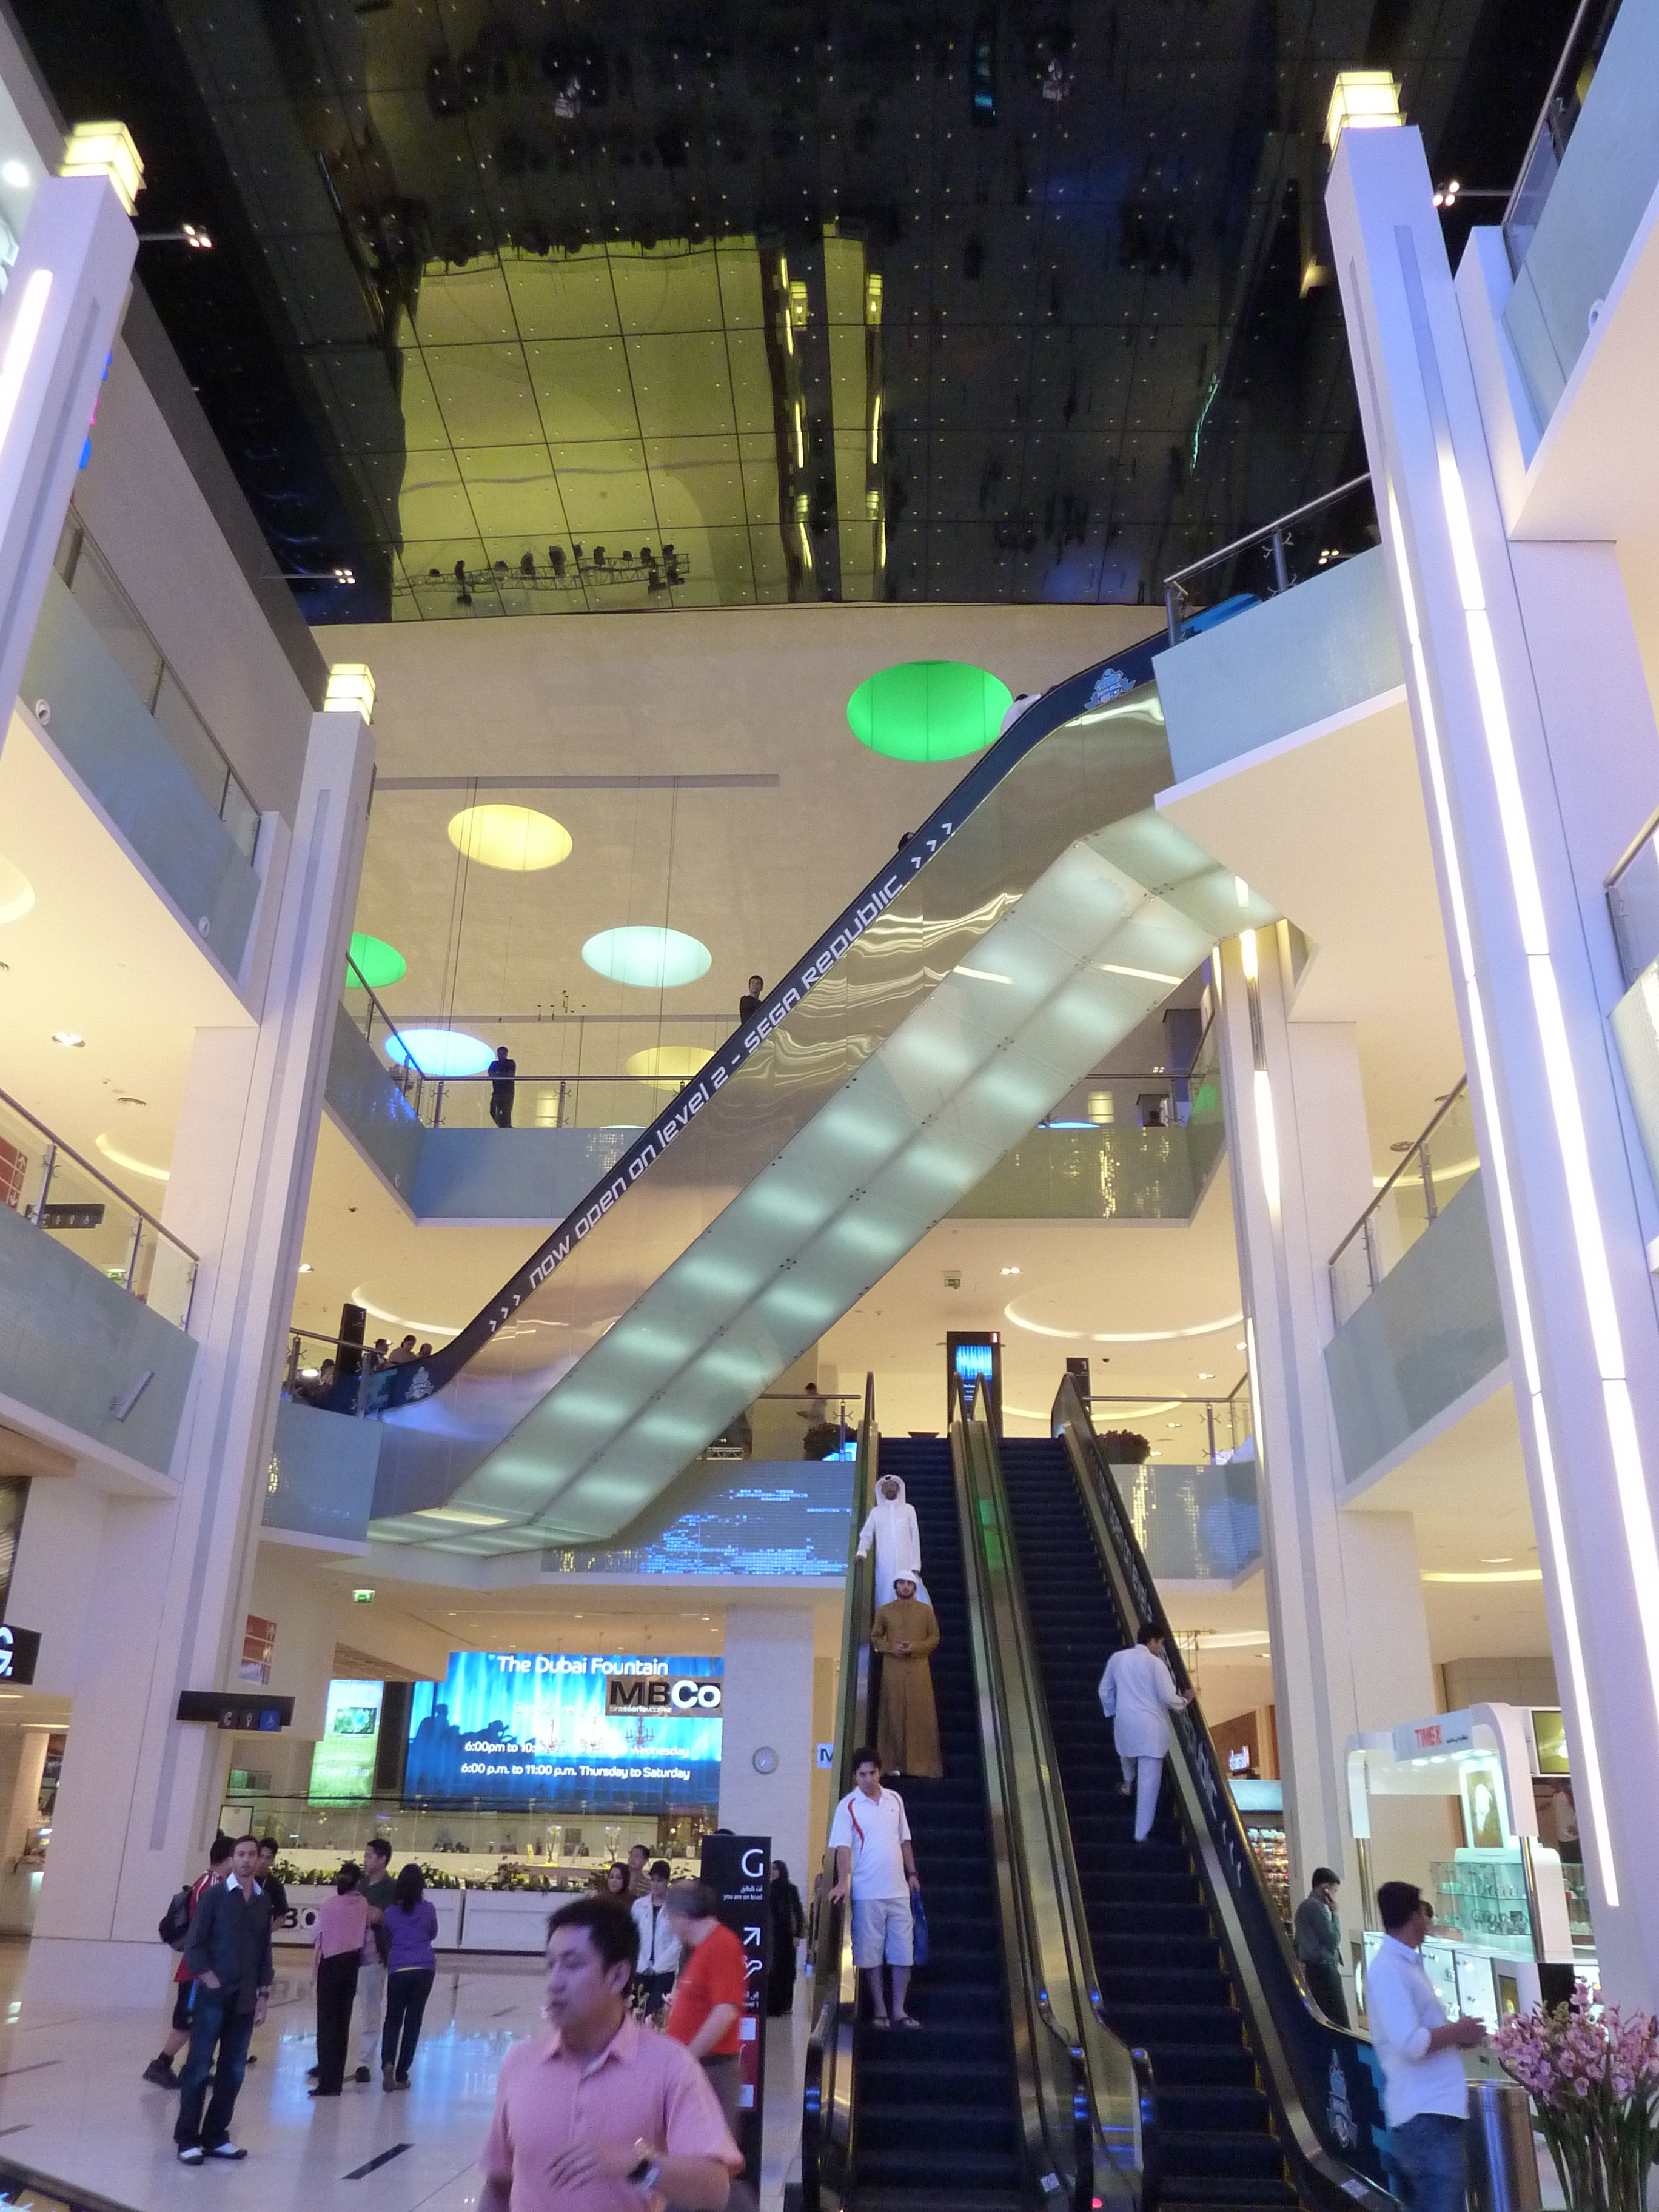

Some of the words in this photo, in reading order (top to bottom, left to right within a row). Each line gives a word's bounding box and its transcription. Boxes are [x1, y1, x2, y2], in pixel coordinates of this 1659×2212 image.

[529, 1235, 569, 1289] now
[575, 1177, 627, 1239] open
[628, 1144, 657, 1181] on
[657, 1082, 710, 1148] level
[711, 1066, 728, 1090] 2
[744, 987, 800, 1053] SEGA
[497, 1656, 532, 1672] The
[535, 1656, 588, 1674] Dubai
[591, 1657, 669, 1675] Fountain
[464, 1741, 506, 1754] 6:00pm
[507, 1743, 518, 1752] to
[631, 1746, 690, 1758] Wednesday
[461, 1763, 486, 1774] 6:00
[486, 1765, 511, 1775] p.m.
[512, 1765, 523, 1774] to
[525, 1765, 553, 1775] 11:00
[554, 1767, 577, 1777] p.m.
[579, 1765, 629, 1779] Thursday
[630, 1768, 642, 1777] to
[643, 1767, 691, 1781] Saturday
[742, 1848, 763, 1877] G
